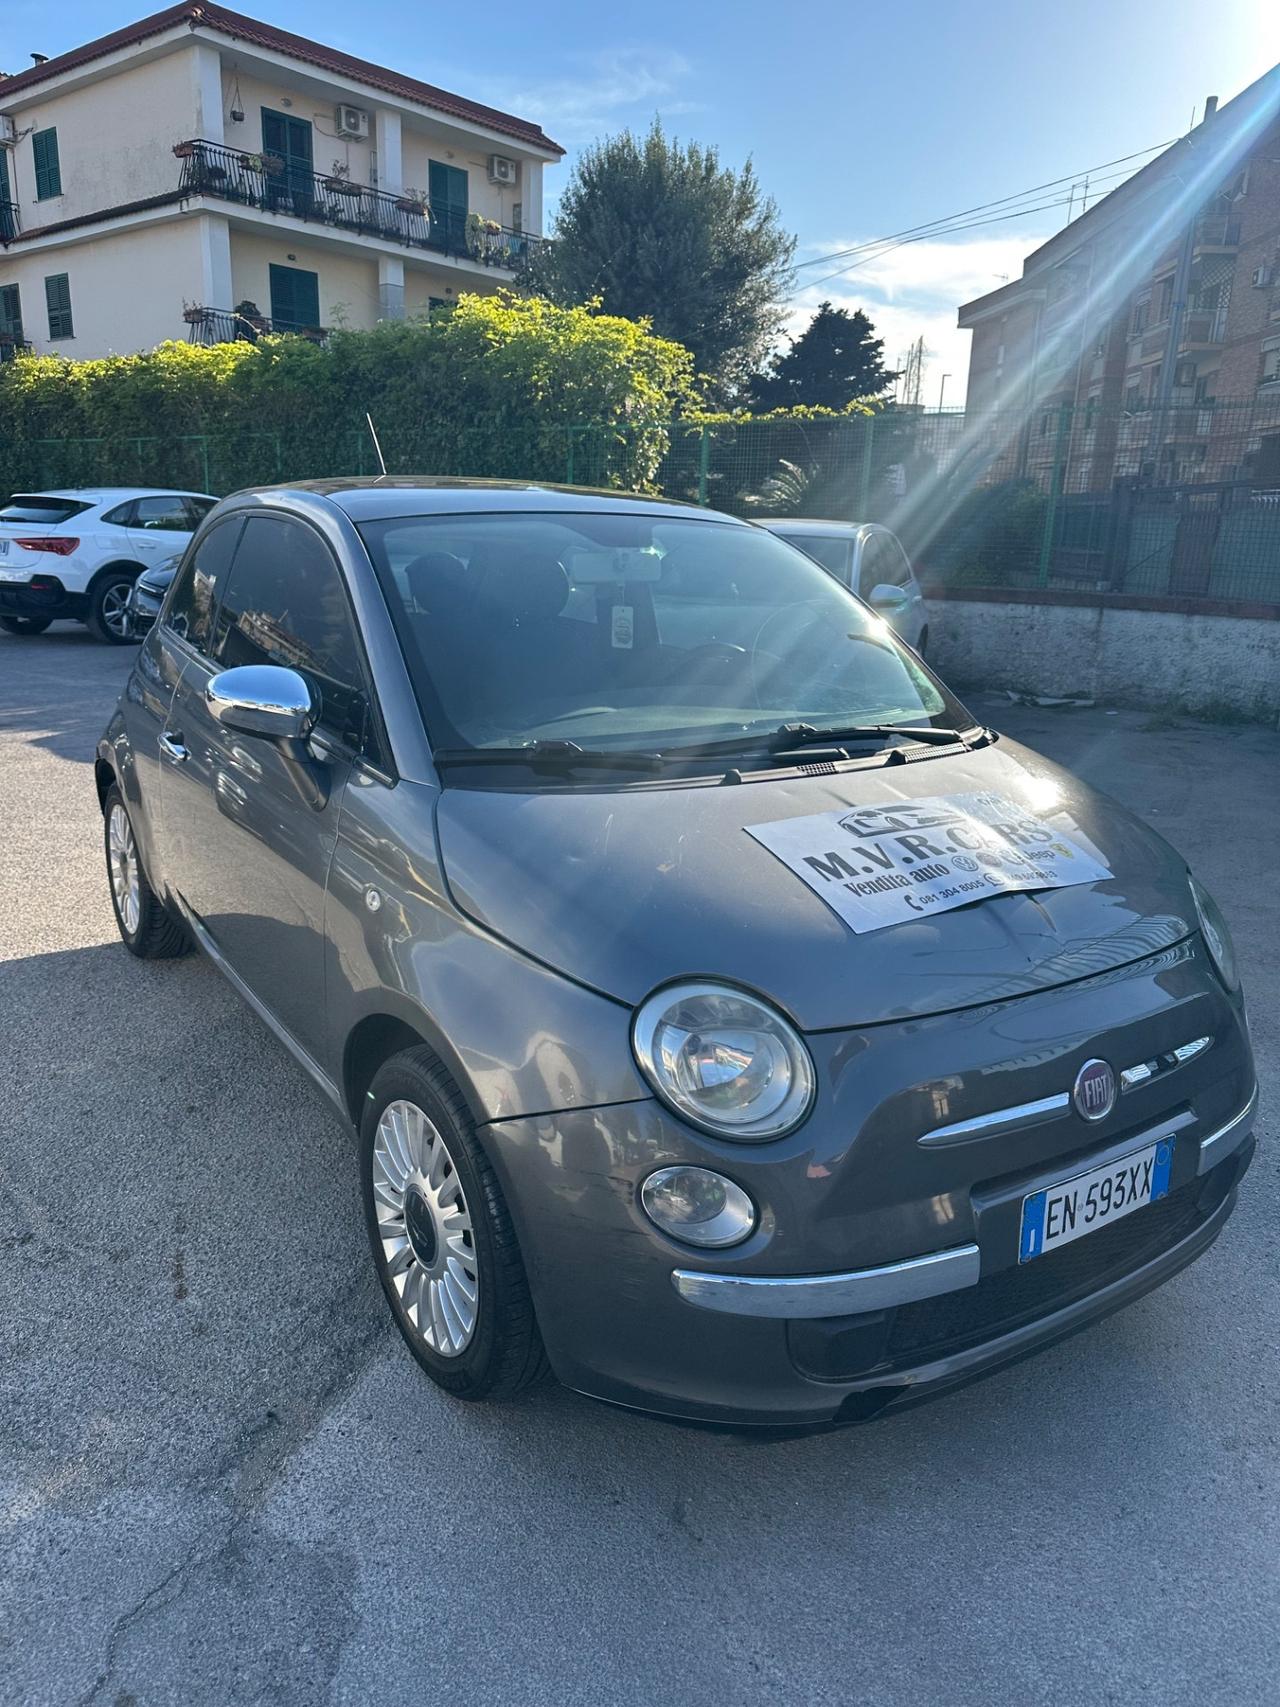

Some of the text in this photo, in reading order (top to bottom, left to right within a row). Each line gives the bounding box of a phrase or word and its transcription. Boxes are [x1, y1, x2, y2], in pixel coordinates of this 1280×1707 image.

[802, 820, 1053, 882] M.V.R.CRS
[1023, 849, 1056, 861] Jeep
[843, 862, 950, 897] Vendita auto
[919, 879, 985, 905] 081 304 8005
[1084, 1074, 1108, 1107] FIAT
[1046, 1156, 1154, 1240] EN 593XX
